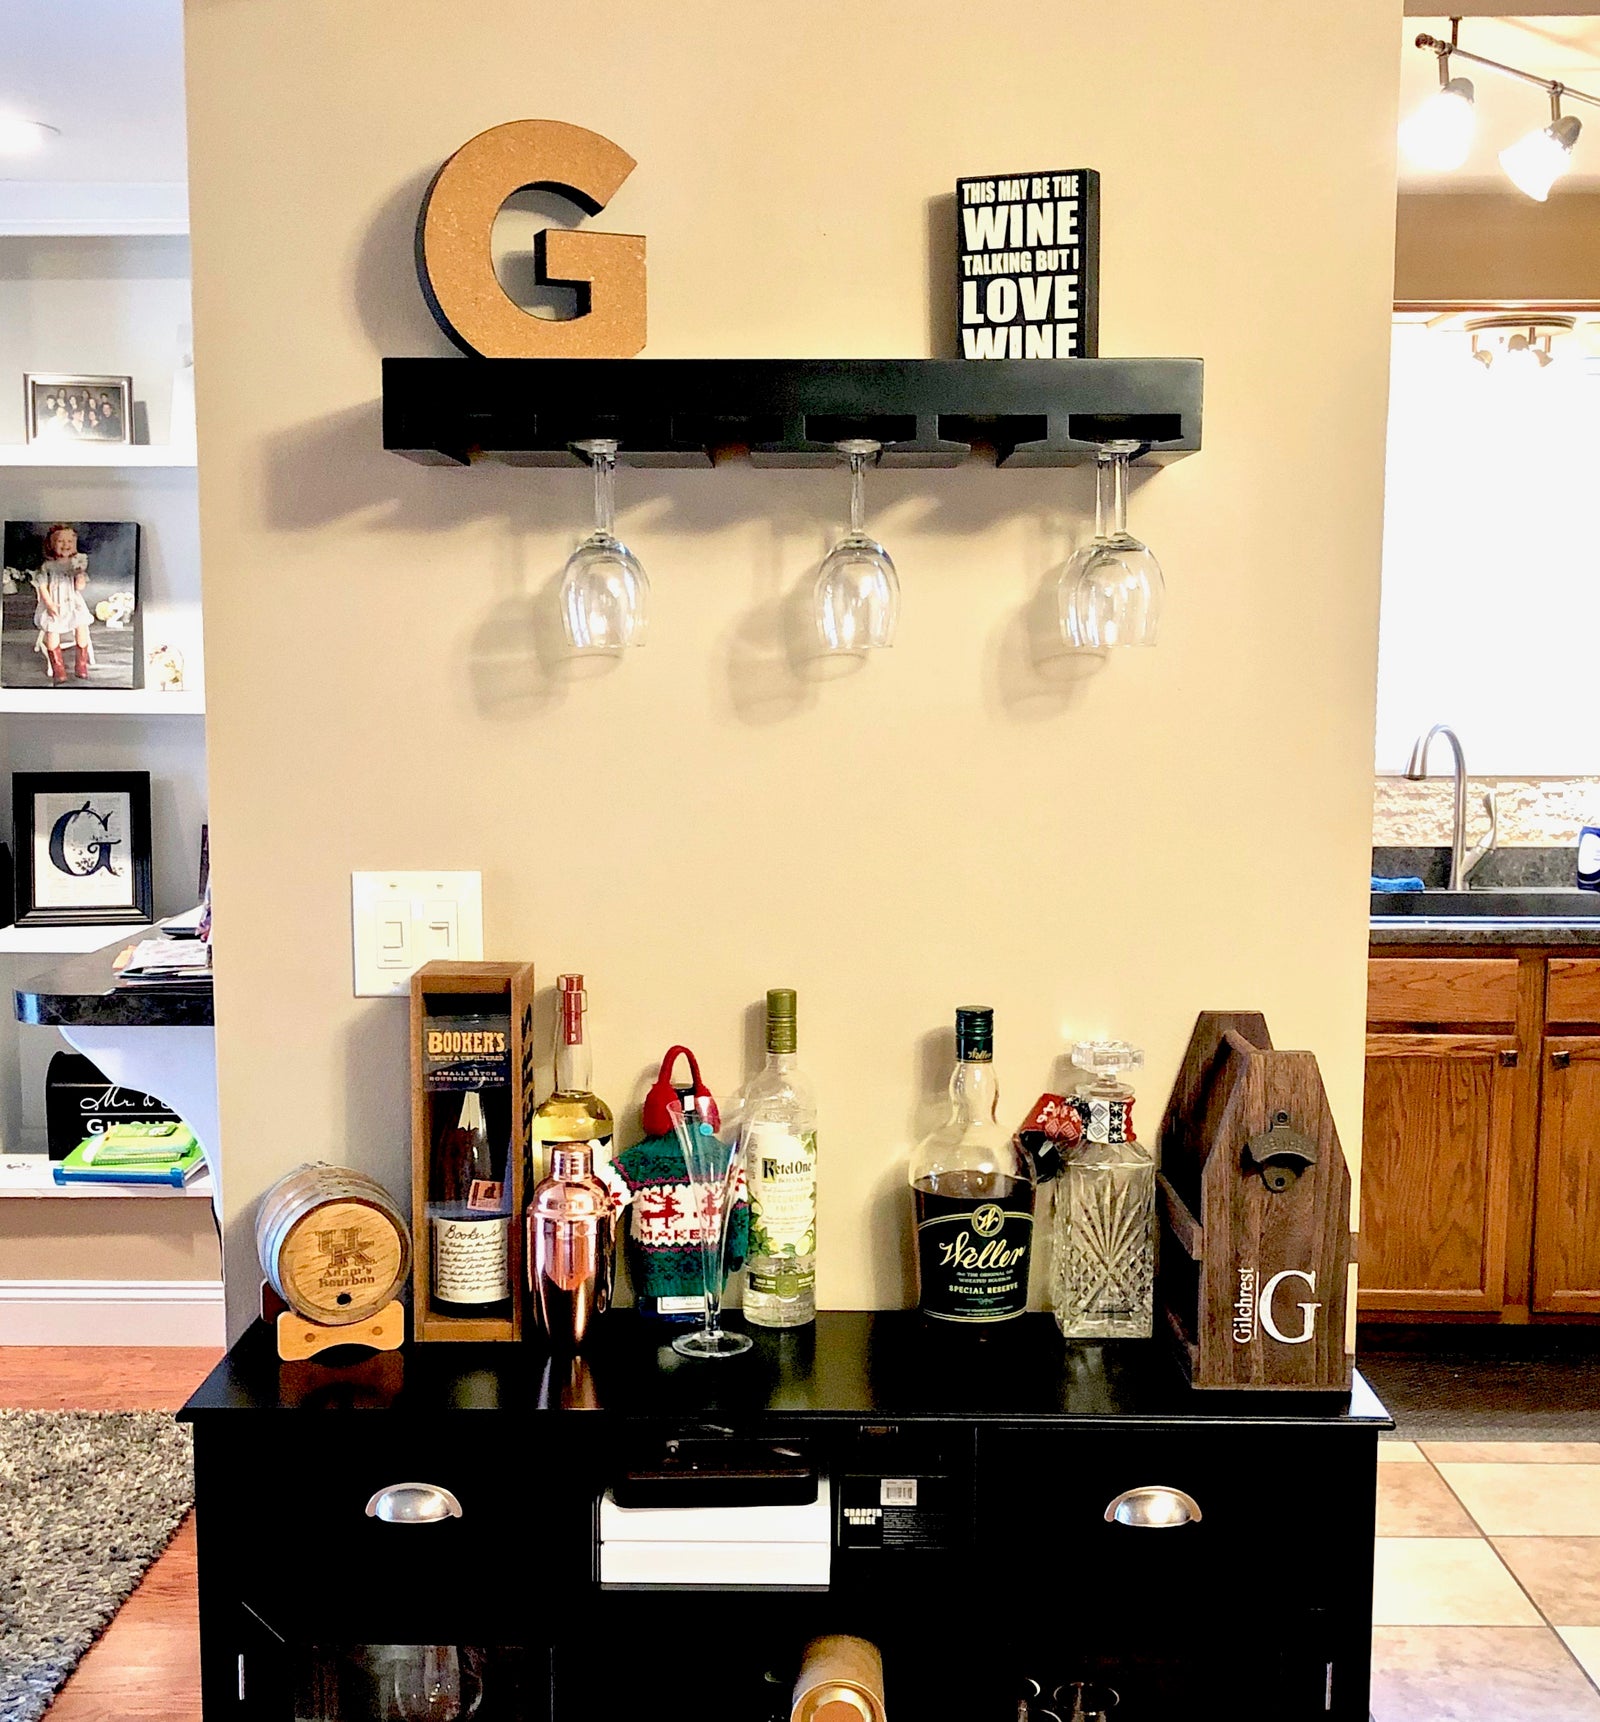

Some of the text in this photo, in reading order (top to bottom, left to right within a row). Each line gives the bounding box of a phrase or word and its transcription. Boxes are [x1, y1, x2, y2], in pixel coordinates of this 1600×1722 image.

[962, 175, 1079, 205] THIS MAY BE THE
[415, 118, 647, 359] G
[962, 200, 1079, 251] WINE
[961, 248, 1080, 276] TALKING BUT I
[962, 274, 1079, 325] LOVE
[962, 322, 1078, 360] WINE
[49, 800, 122, 877] G
[428, 1031, 505, 1054] BOOKER'S
[80, 1085, 136, 1111] Mr.
[763, 1160, 812, 1181] Ketel One
[938, 1231, 1027, 1269] Weller
[318, 1276, 376, 1288] Bourbon
[949, 1284, 985, 1295] SPECIAL
[1232, 1267, 1322, 1344] Gilchrest G
[843, 1508, 883, 1517] SHARPER
[849, 1516, 876, 1525] IMAGE
